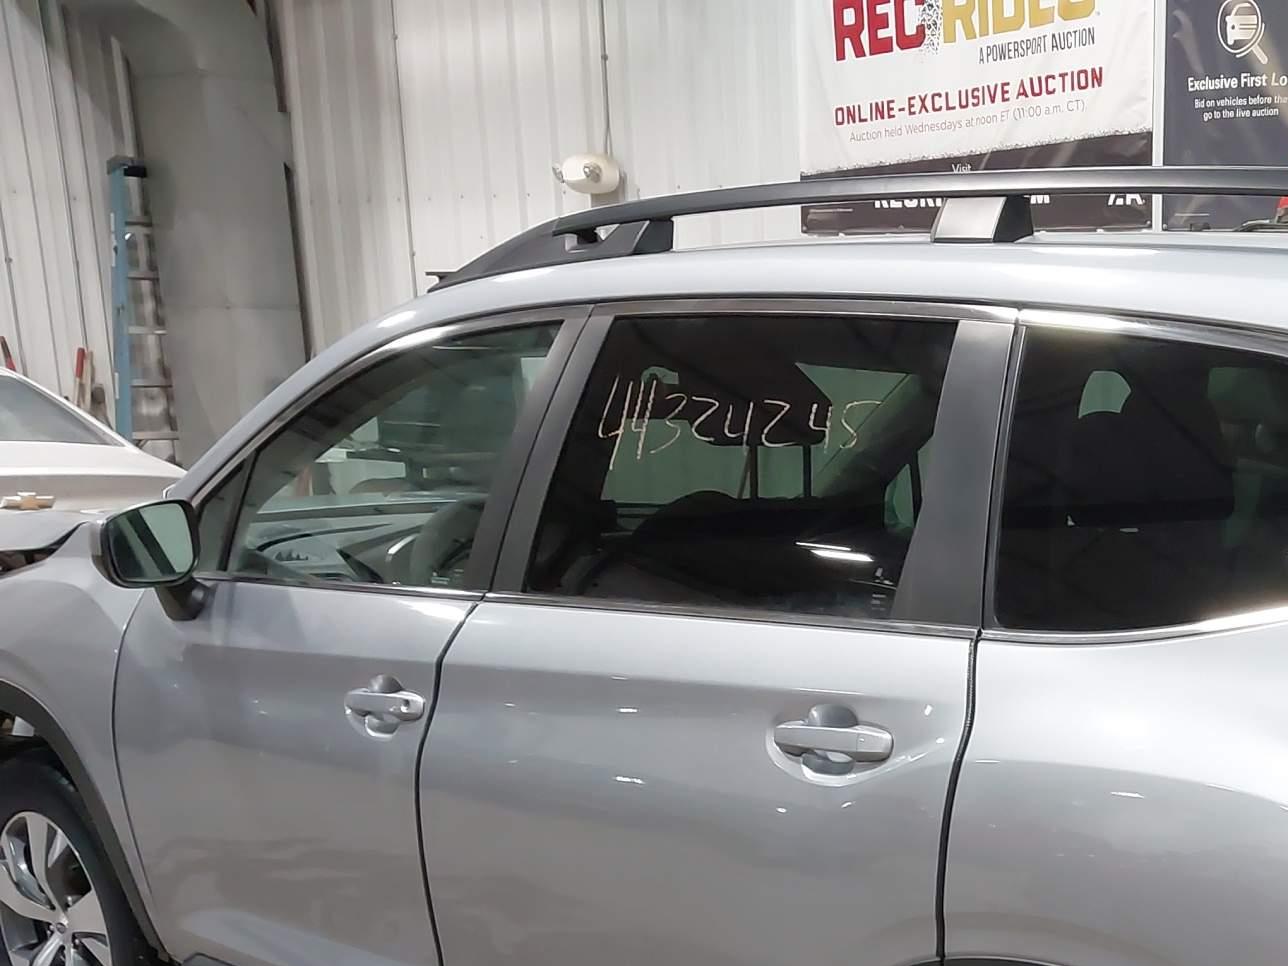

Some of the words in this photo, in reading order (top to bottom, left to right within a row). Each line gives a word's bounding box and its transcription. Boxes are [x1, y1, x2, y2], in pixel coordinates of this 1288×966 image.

[979, 47, 984, 64] A
[986, 35, 1047, 63] POWERSPORT
[1051, 27, 1095, 52] AUCTION
[1188, 75, 1238, 92] Exclusive
[1240, 73, 1268, 87] First
[835, 82, 1010, 126] ONLINE-EXCLUSIVE
[1016, 66, 1103, 99] AUCTION
[1194, 98, 1204, 108] Bid
[1216, 96, 1247, 107] vehicles
[1248, 95, 1272, 105] before
[849, 130, 882, 142] Auction
[884, 125, 902, 138] held
[904, 117, 962, 136] Wednesdays
[965, 117, 975, 128] at
[976, 113, 997, 126] noon
[1000, 110, 1009, 122] ET
[1203, 111, 1213, 121] go
[1214, 110, 1221, 119] to
[1222, 109, 1234, 118] the
[1236, 108, 1250, 118] live
[1252, 107, 1279, 117] auction
[952, 164, 971, 173] Visit
[598, 375, 882, 471] 44324245
